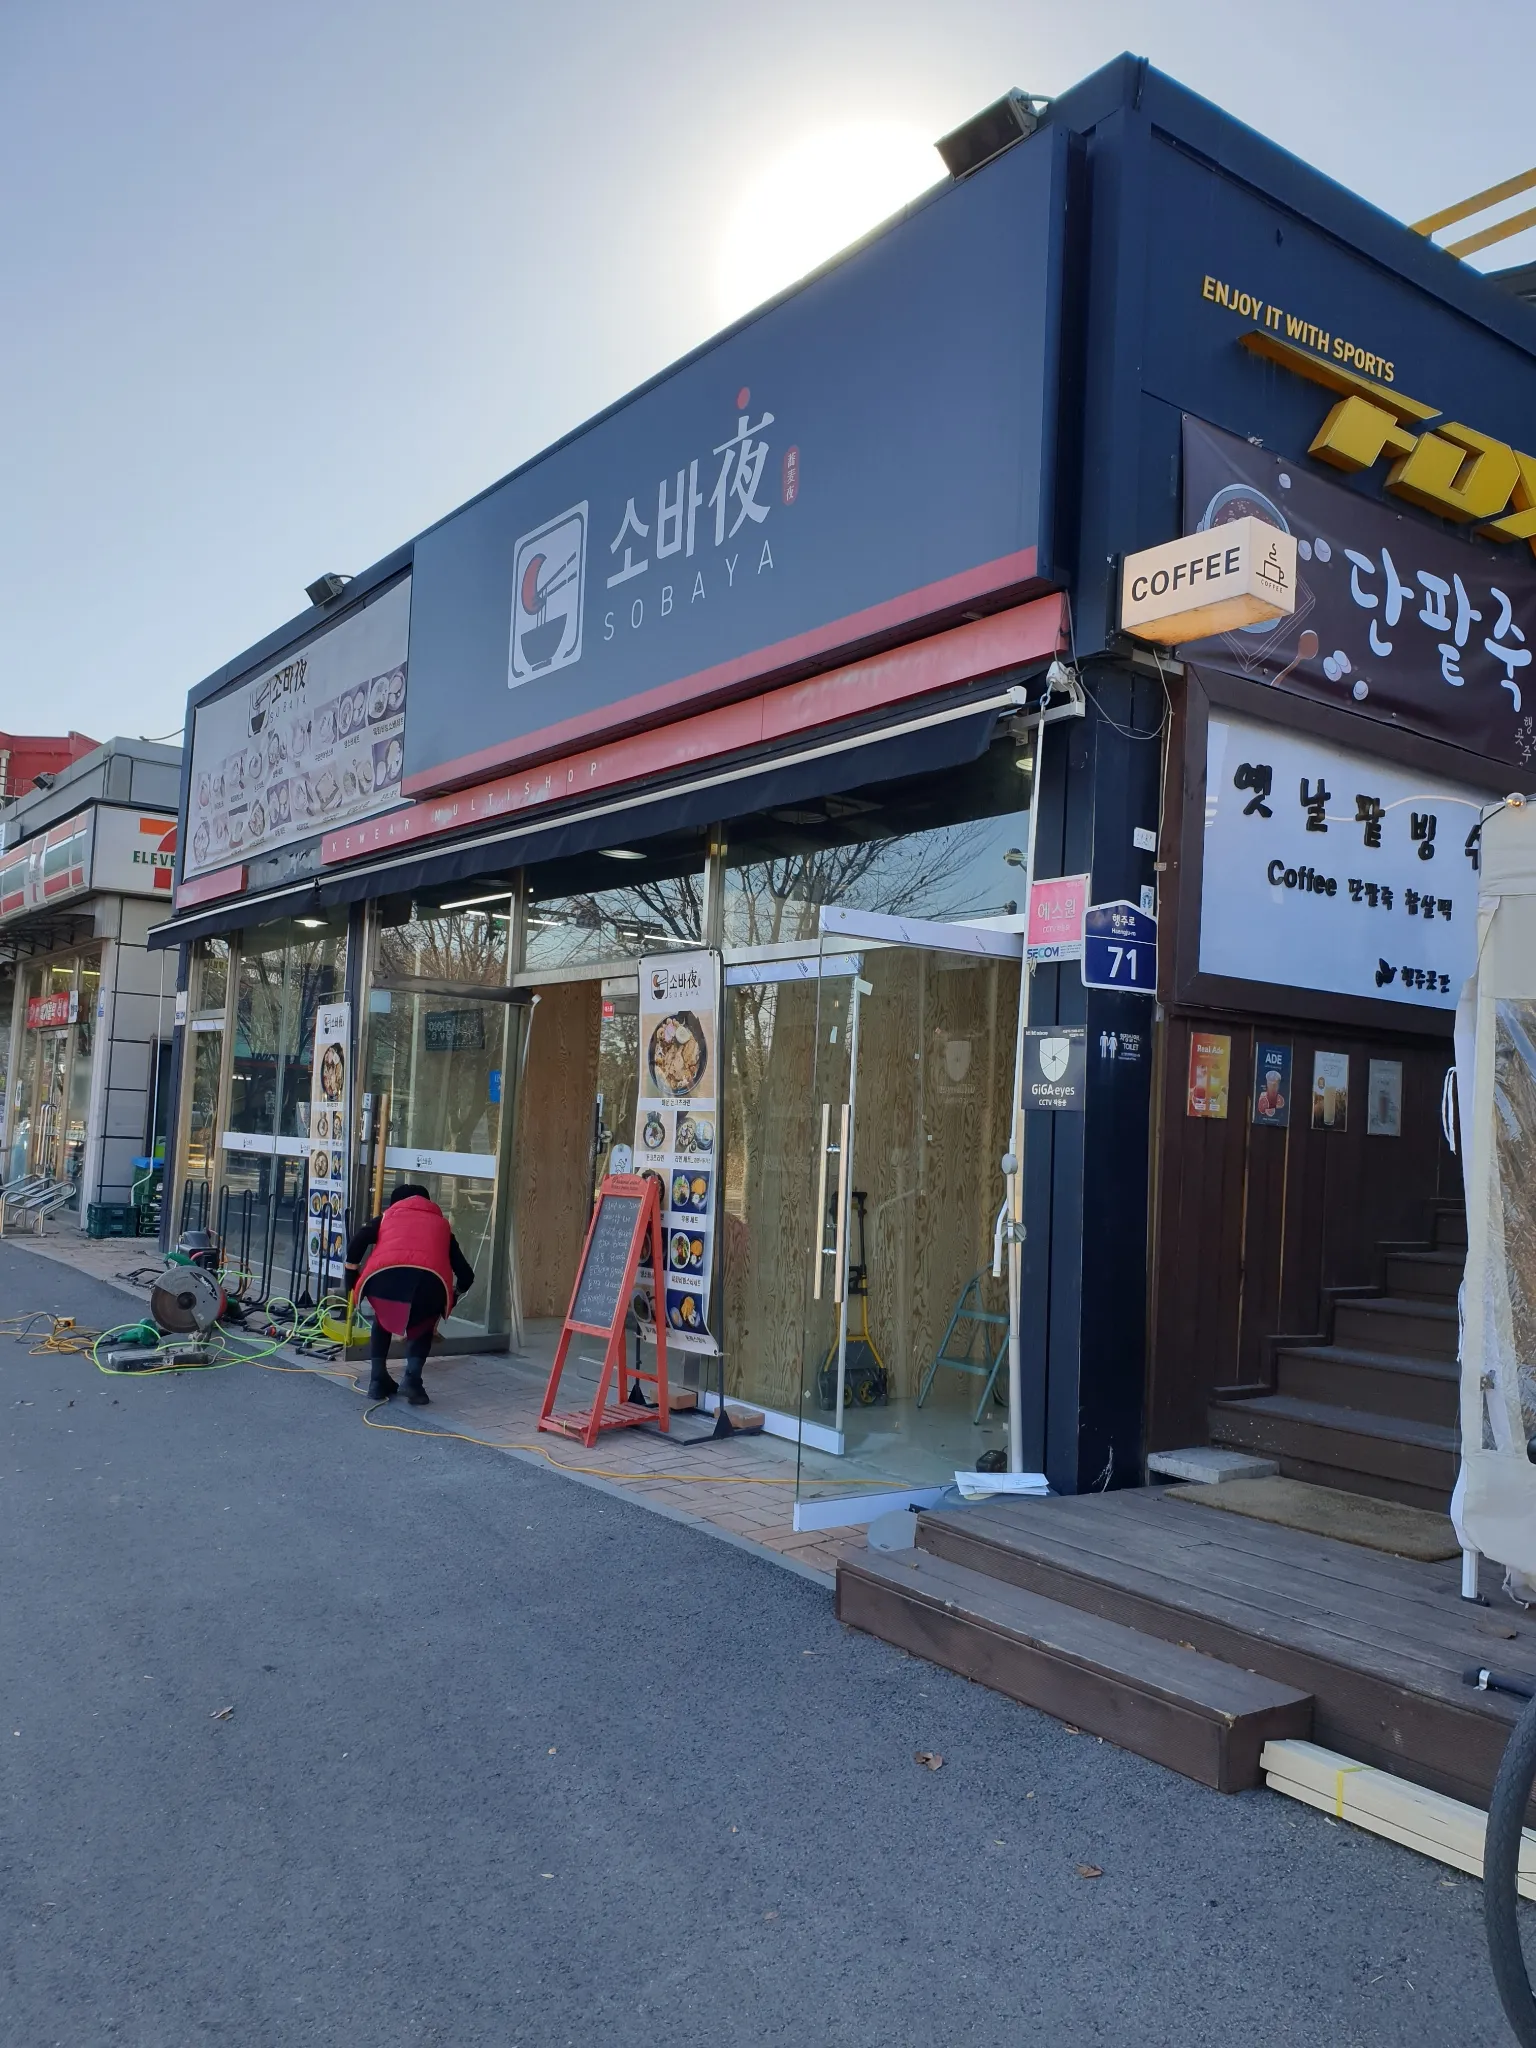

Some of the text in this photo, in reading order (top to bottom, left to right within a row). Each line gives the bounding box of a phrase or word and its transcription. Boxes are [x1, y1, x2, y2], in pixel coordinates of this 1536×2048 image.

[1202, 275, 1396, 383] ENJOY IT WITH SPORTS
[1131, 546, 1241, 602] COFFEE
[603, 539, 775, 641] SOBAYA
[1260, 578, 1284, 595] COFFEE
[1344, 547, 1532, 713] 단팥죽
[132, 850, 176, 867] ELEVE
[1267, 859, 1338, 897] Coffee
[1348, 878, 1394, 911] 단팥죽
[1037, 898, 1076, 921] 에스원
[1112, 913, 1136, 927] 행주로
[1026, 946, 1060, 960] SECOM
[1107, 946, 1137, 981] 71
[669, 967, 698, 990] 소바夜
[1122, 1042, 1139, 1051] TOILET
[1196, 1044, 1224, 1055] Real Ade
[1265, 1053, 1283, 1065] ADE
[1038, 1098, 1053, 1106] CCTV
